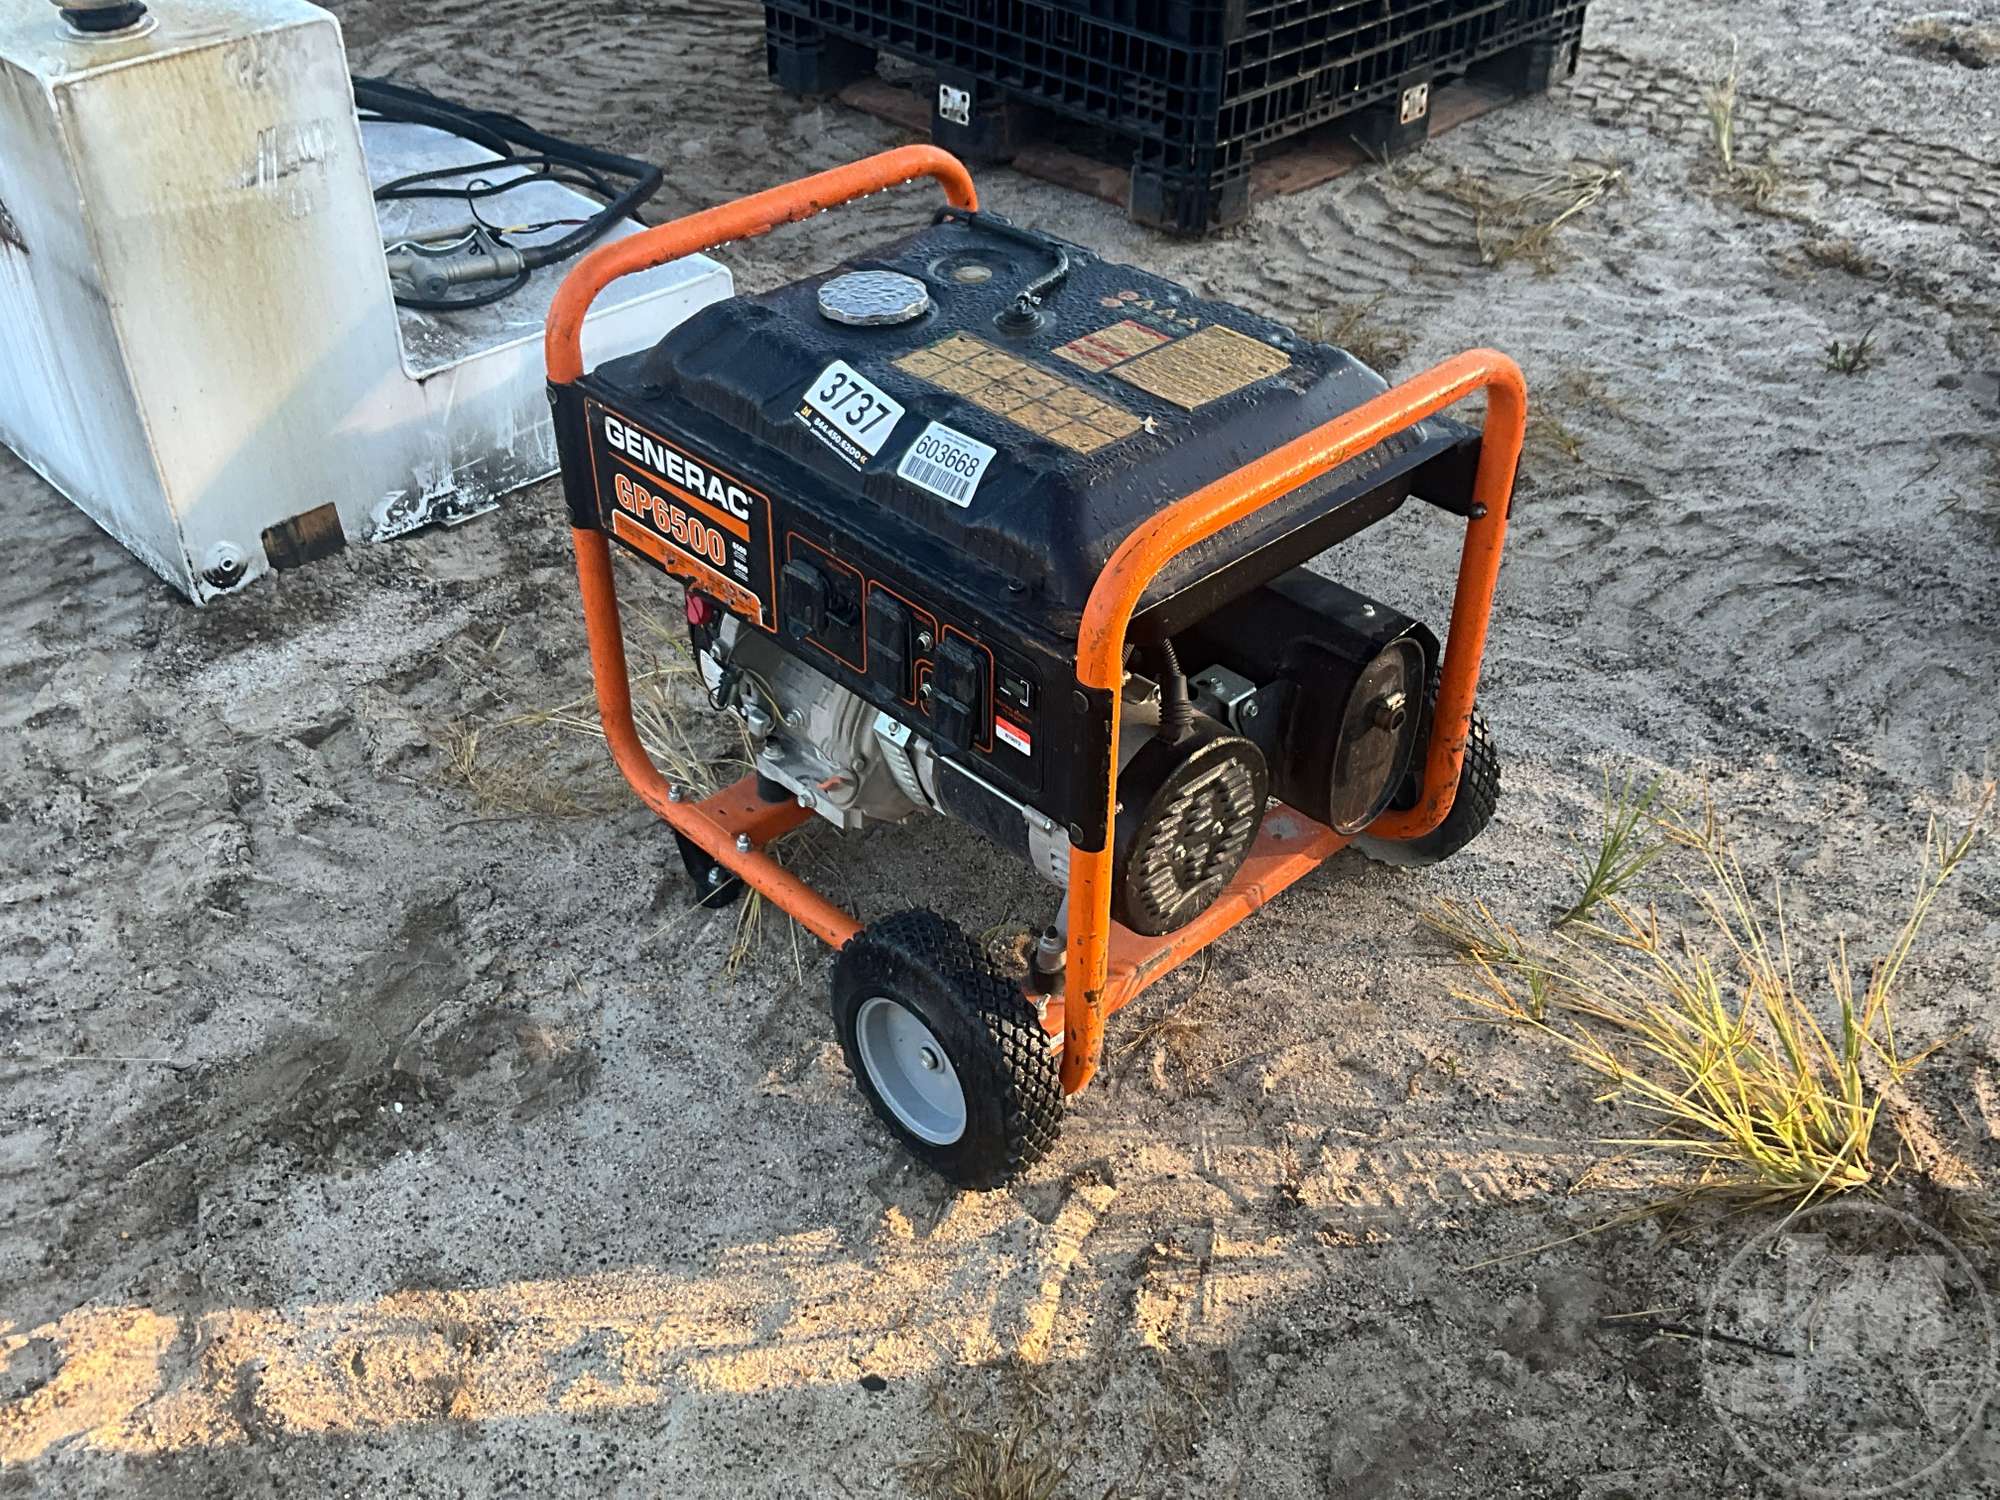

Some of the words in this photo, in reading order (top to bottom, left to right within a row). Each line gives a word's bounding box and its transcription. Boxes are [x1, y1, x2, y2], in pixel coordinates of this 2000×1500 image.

[819, 372, 892, 434] 3737
[604, 415, 749, 521] GENERAC
[915, 435, 980, 478] 603668
[614, 473, 727, 567] GP6500
